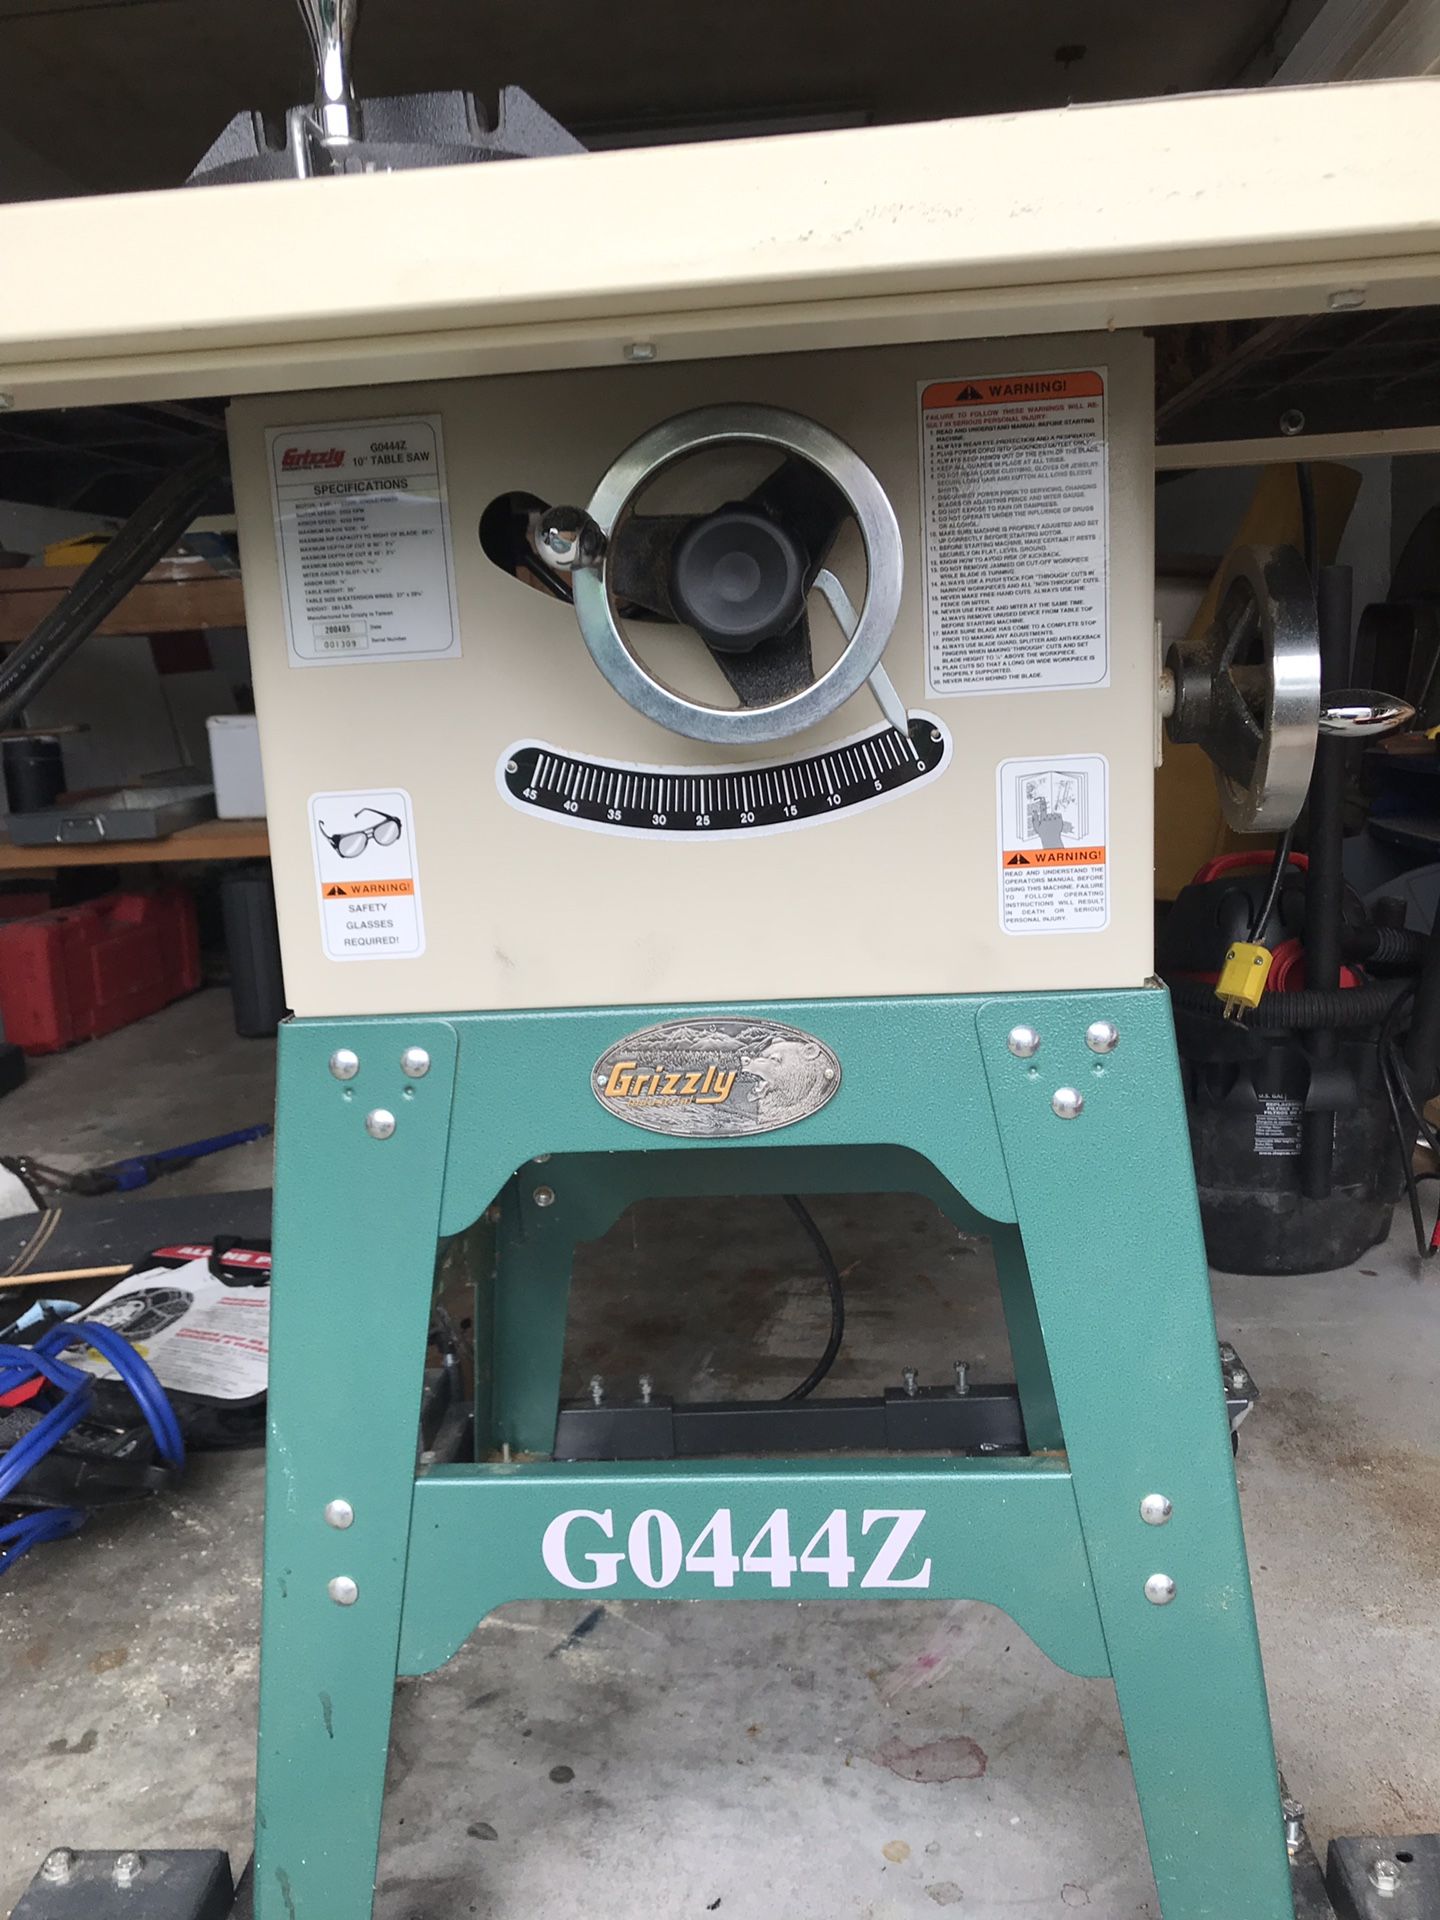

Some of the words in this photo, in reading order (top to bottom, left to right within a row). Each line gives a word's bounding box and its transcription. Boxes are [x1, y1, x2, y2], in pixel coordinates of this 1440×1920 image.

[988, 380, 1066, 397] WARNING!
[352, 455, 368, 467] 10"
[370, 452, 404, 465] TABLE
[405, 450, 430, 463] SAW
[312, 479, 408, 495] SPECIFICATIONS
[324, 624, 350, 634] 200405
[522, 788, 538, 800] 45
[563, 801, 579, 812] 40
[607, 809, 622, 821] 35
[652, 815, 667, 826] 30
[696, 816, 710, 826] 25
[740, 812, 755, 823] 20
[784, 805, 798, 817] 15
[826, 794, 842, 806] 10
[874, 781, 883, 792] 5
[917, 761, 926, 772] 0
[1035, 850, 1101, 862] WARNING!
[351, 883, 410, 893] WARNING!
[349, 903, 387, 913] SAFETY
[1006, 900, 1054, 908] INSTRUCTIONS
[346, 919, 394, 930] GLASSES
[344, 936, 399, 947] REQUIRED!
[604, 1062, 737, 1104] Grizzly
[542, 1508, 932, 1590] G0444Z
